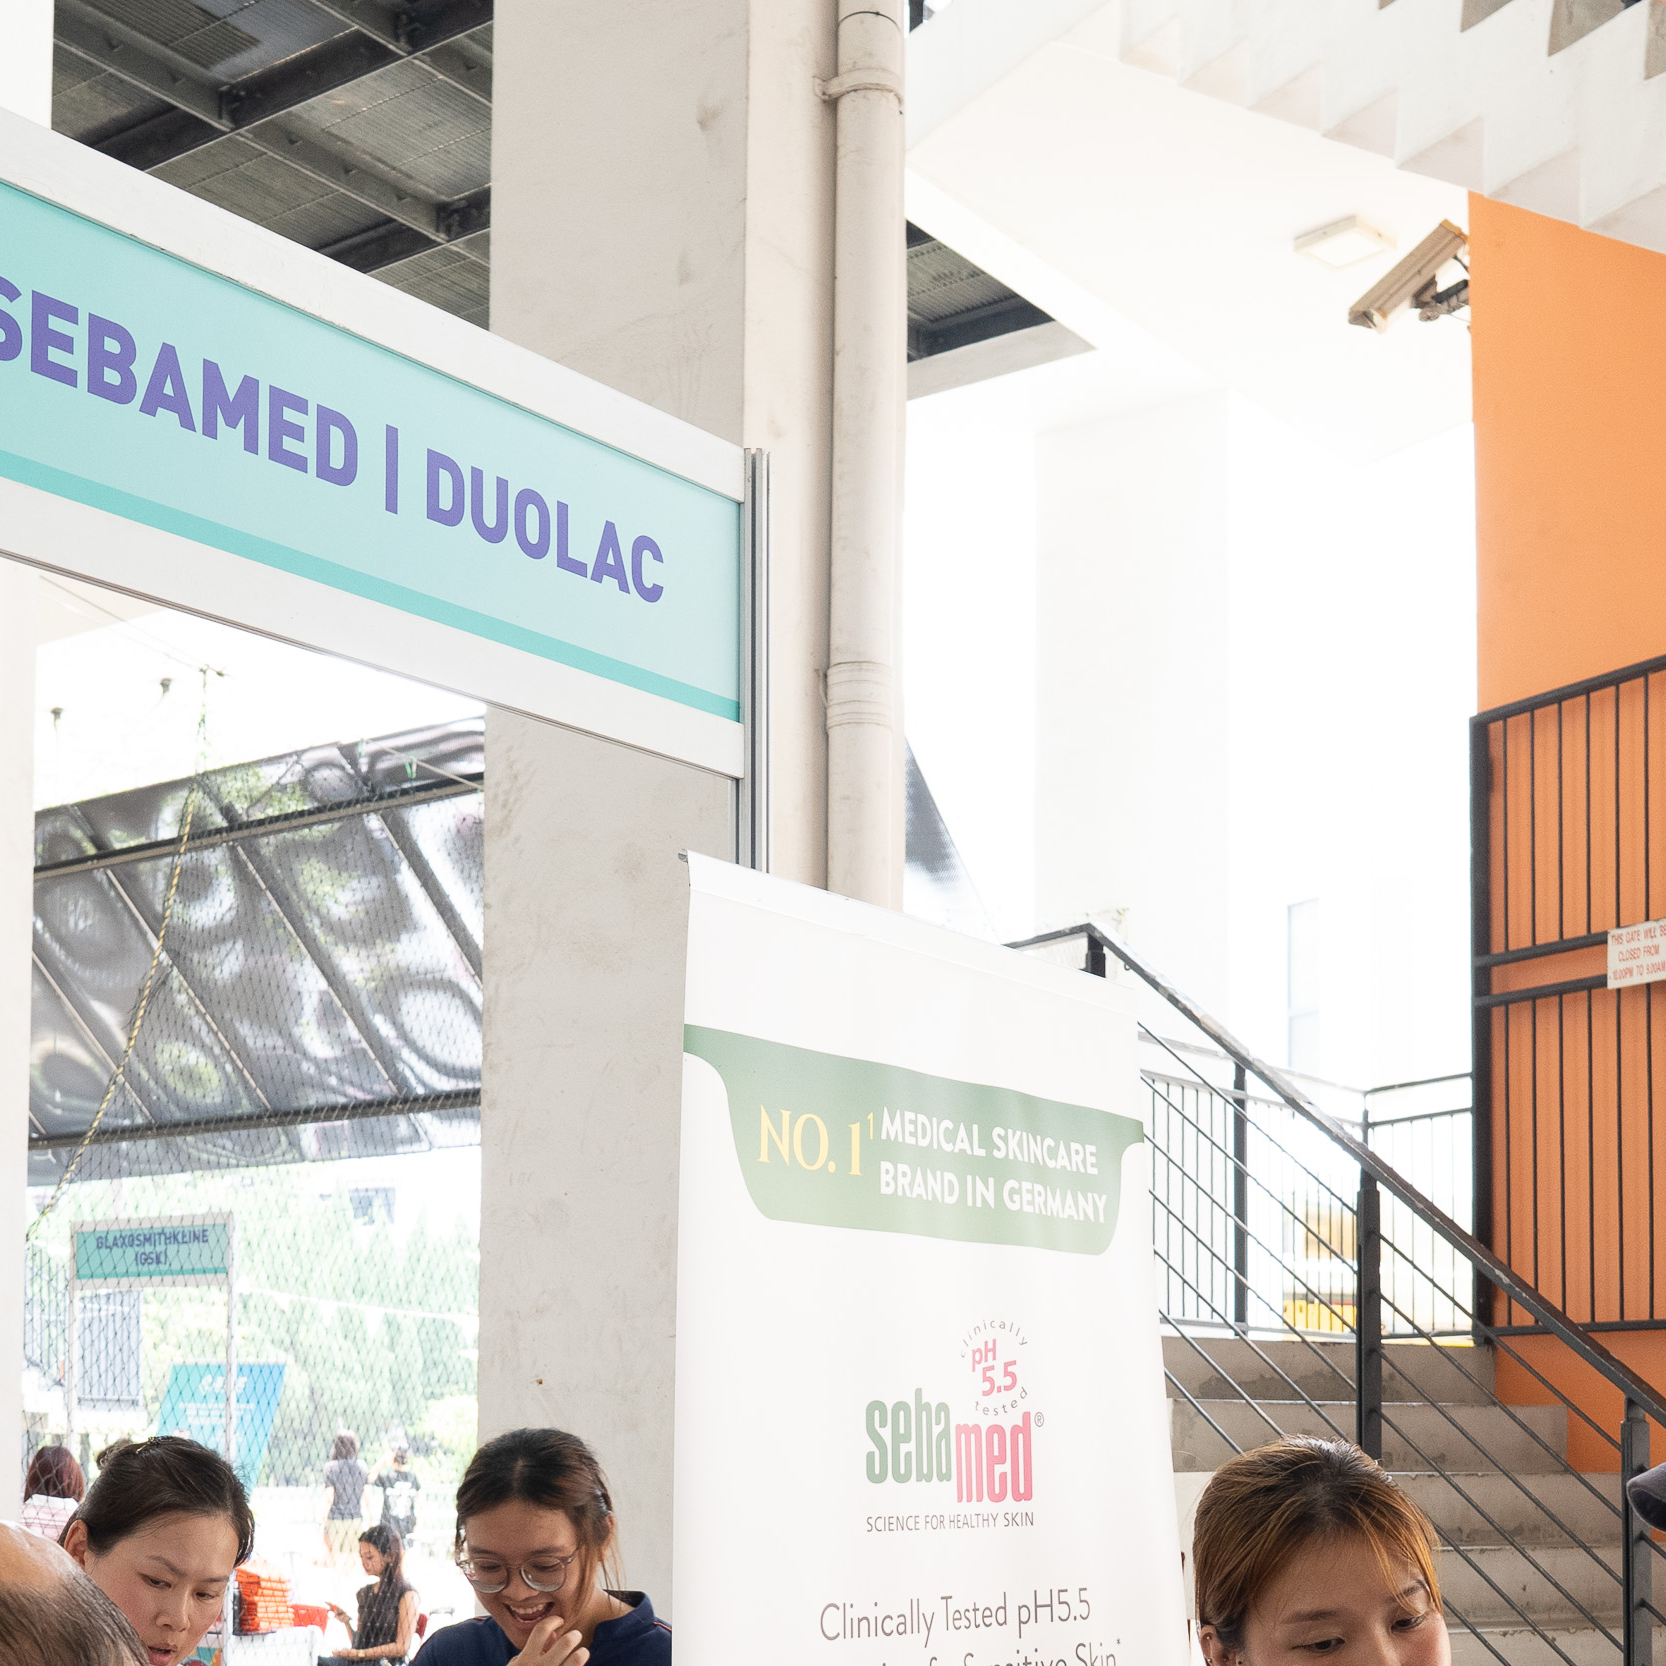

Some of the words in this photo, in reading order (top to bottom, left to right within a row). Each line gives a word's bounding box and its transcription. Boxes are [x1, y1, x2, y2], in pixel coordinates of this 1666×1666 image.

[426, 450, 664, 603] DUOLAC
[1611, 934, 1623, 945] THIS
[1626, 930, 1640, 943] GATE
[1643, 927, 1656, 939] WILL
[1660, 924, 1666, 936] BE
[1618, 947, 1641, 962] CLOSED
[1643, 944, 1660, 957] FROM
[1636, 964, 1643, 976] TO
[757, 1104, 836, 1174] NO.
[881, 1106, 985, 1157] MEDICAL
[992, 1126, 1099, 1175] SKINCARE
[880, 1161, 959, 1205] BRAND
[967, 1175, 995, 1209] IN
[1002, 1179, 1107, 1224] GERMANY
[96, 1229, 208, 1249] GLAXOSMITHKLINE
[135, 1251, 168, 1265] (GSK)
[960, 1319, 1029, 1358] clinically
[972, 1338, 997, 1372] pH
[982, 1360, 1017, 1397] 5.5
[974, 1387, 1028, 1416] tested
[866, 1515, 920, 1532] SCIENCE
[925, 1515, 945, 1530] FOR
[949, 1513, 999, 1529] HEALTHY
[1004, 1512, 1034, 1527] SKIN
[819, 1598, 935, 1648] Clinically
[940, 1591, 1007, 1631] Tested
[1018, 1587, 1091, 1639] pH5.5
